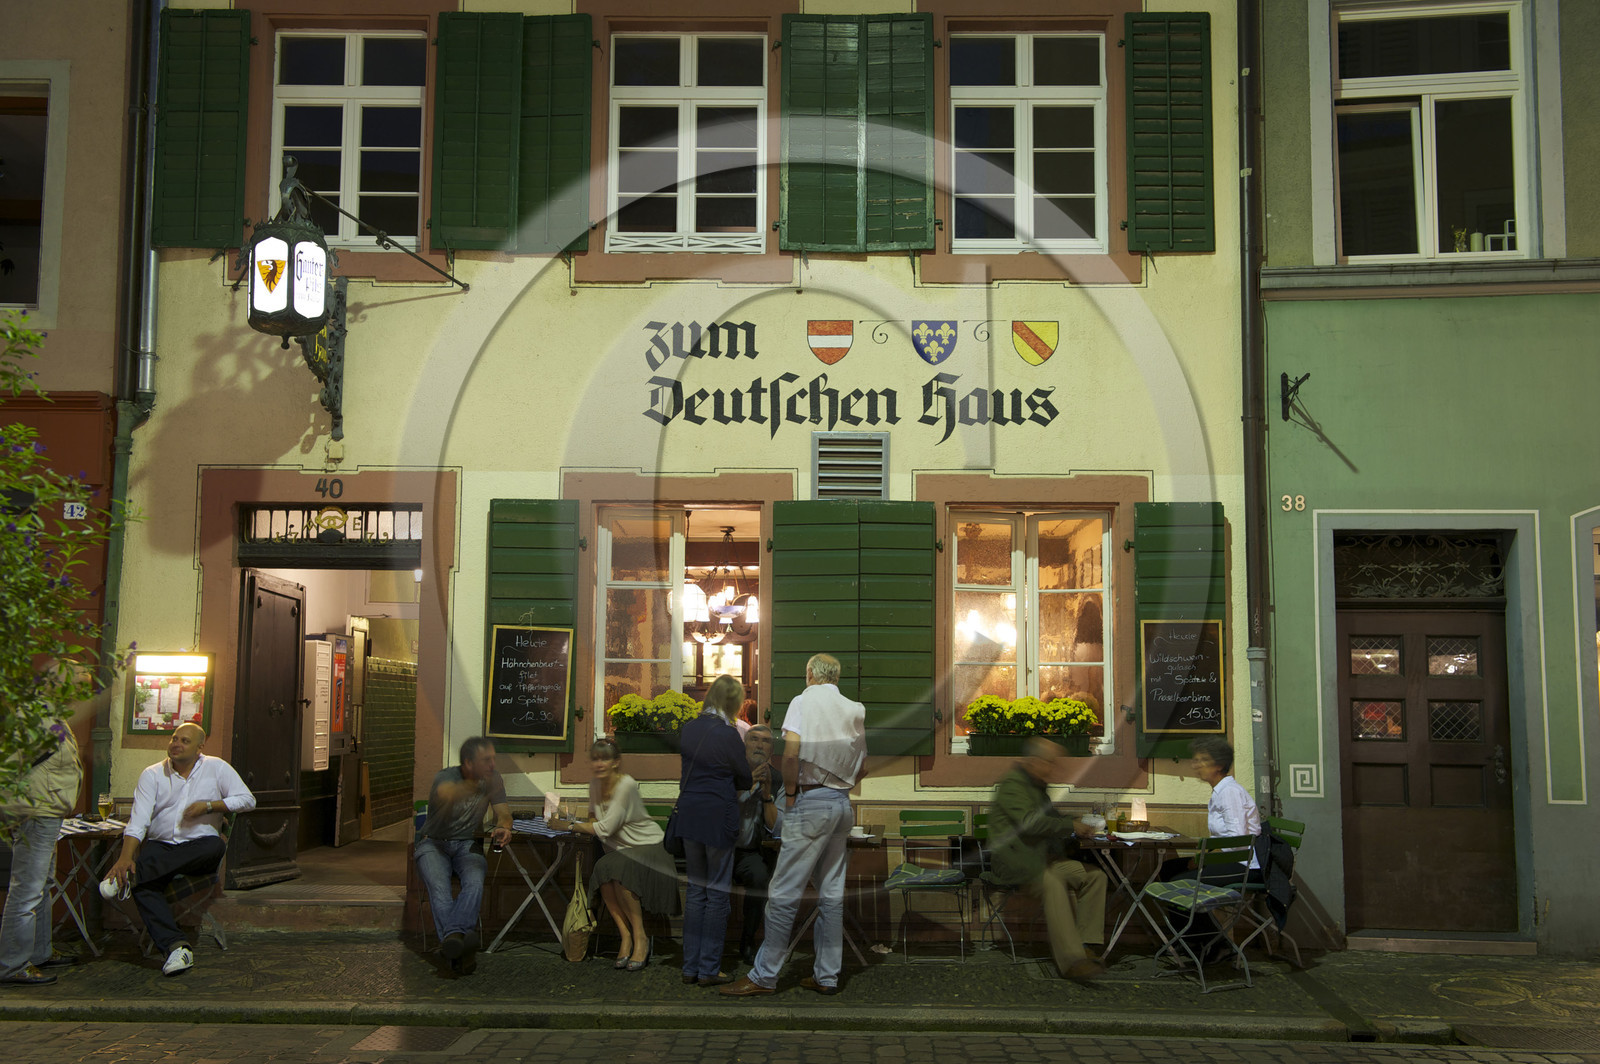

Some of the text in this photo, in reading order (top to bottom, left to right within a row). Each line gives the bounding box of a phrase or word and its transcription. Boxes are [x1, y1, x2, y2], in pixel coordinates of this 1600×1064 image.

[917, 373, 1061, 446] Haus
[315, 478, 344, 499] 40
[1281, 494, 1306, 511] 38
[66, 504, 85, 518] 42
[515, 635, 547, 648] Heute
[1208, 671, 1217, 684] &
[500, 697, 513, 705] und
